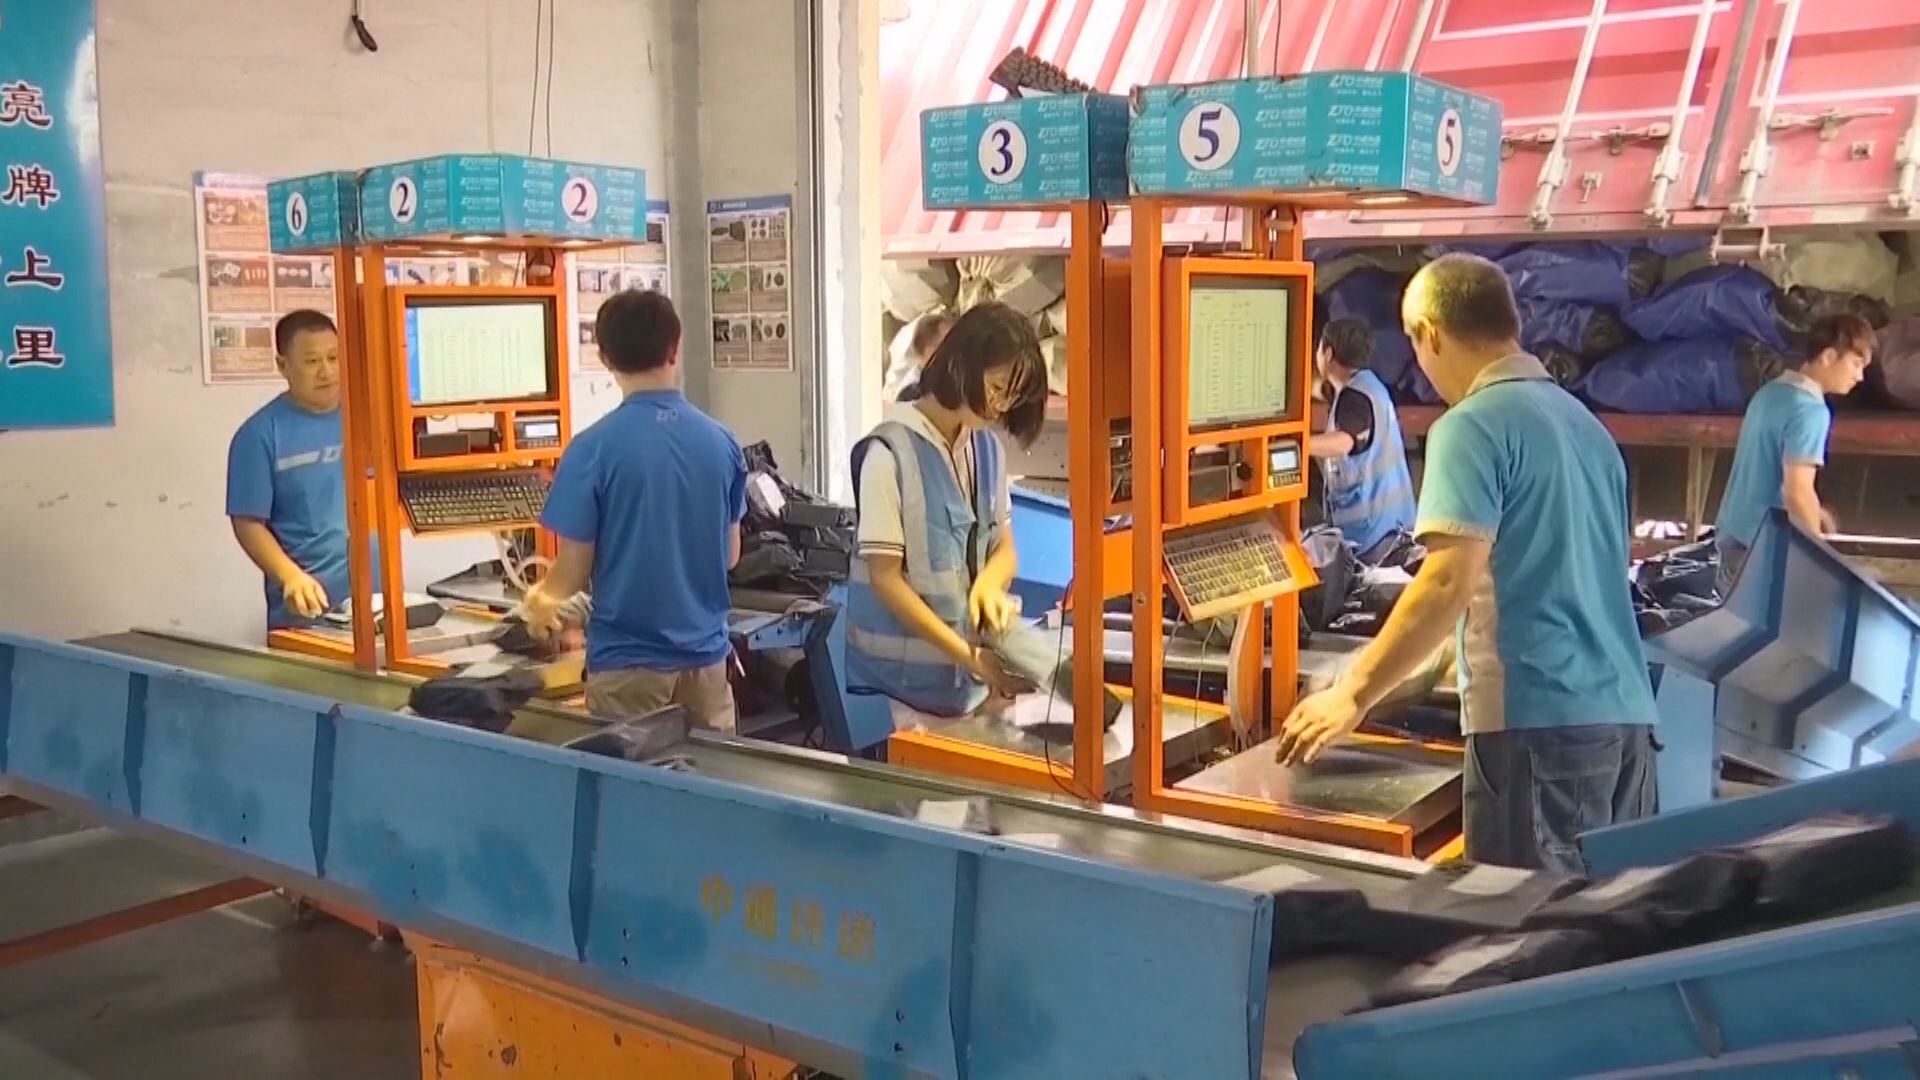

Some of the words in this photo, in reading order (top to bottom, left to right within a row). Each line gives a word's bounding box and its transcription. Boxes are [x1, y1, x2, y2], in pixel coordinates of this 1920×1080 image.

[0, 80, 53, 129] 亮
[990, 128, 1014, 176] 3
[1194, 107, 1222, 162] 5
[1442, 118, 1456, 166] 5
[3, 166, 60, 208] 牌
[396, 183, 409, 217] 2
[572, 183, 588, 217] 2
[291, 197, 302, 230] 6
[5, 246, 64, 290] 上
[7, 325, 64, 368] 里
